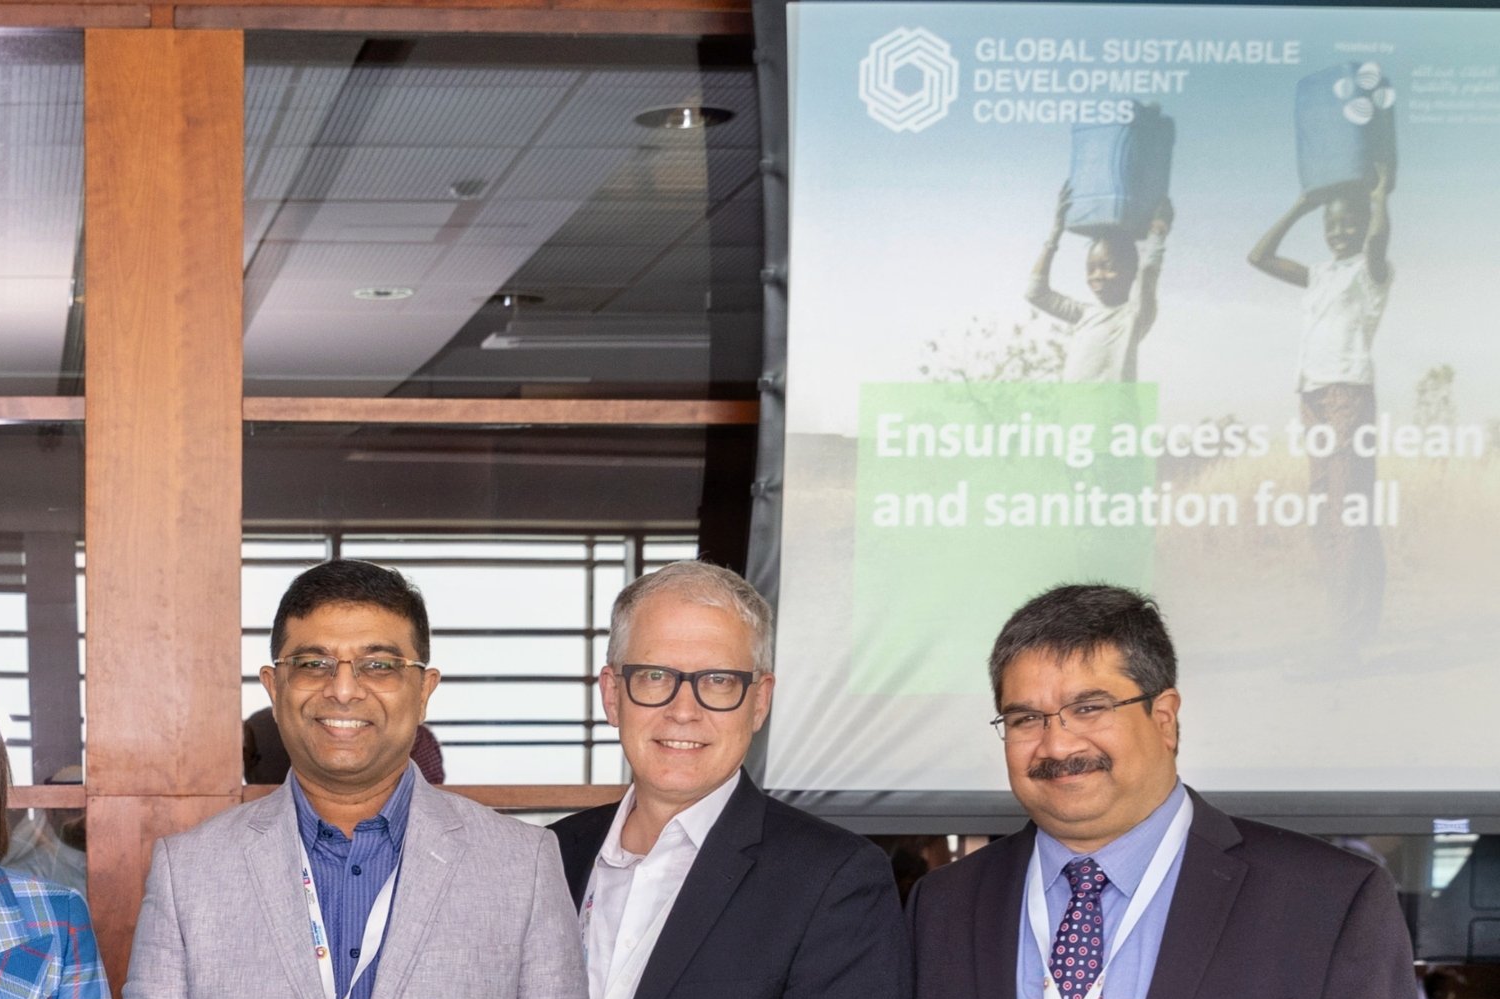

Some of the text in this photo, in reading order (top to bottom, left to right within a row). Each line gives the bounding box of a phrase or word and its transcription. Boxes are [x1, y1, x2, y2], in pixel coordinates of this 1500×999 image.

[974, 37, 1301, 65] GLOBAL SUSTAINABLE
[973, 68, 1190, 94] DEVELOPMENT
[972, 99, 1136, 125] CONGRESS
[875, 411, 1486, 469] Ensuring access to clean
[872, 479, 1400, 528] and sanitation for all
